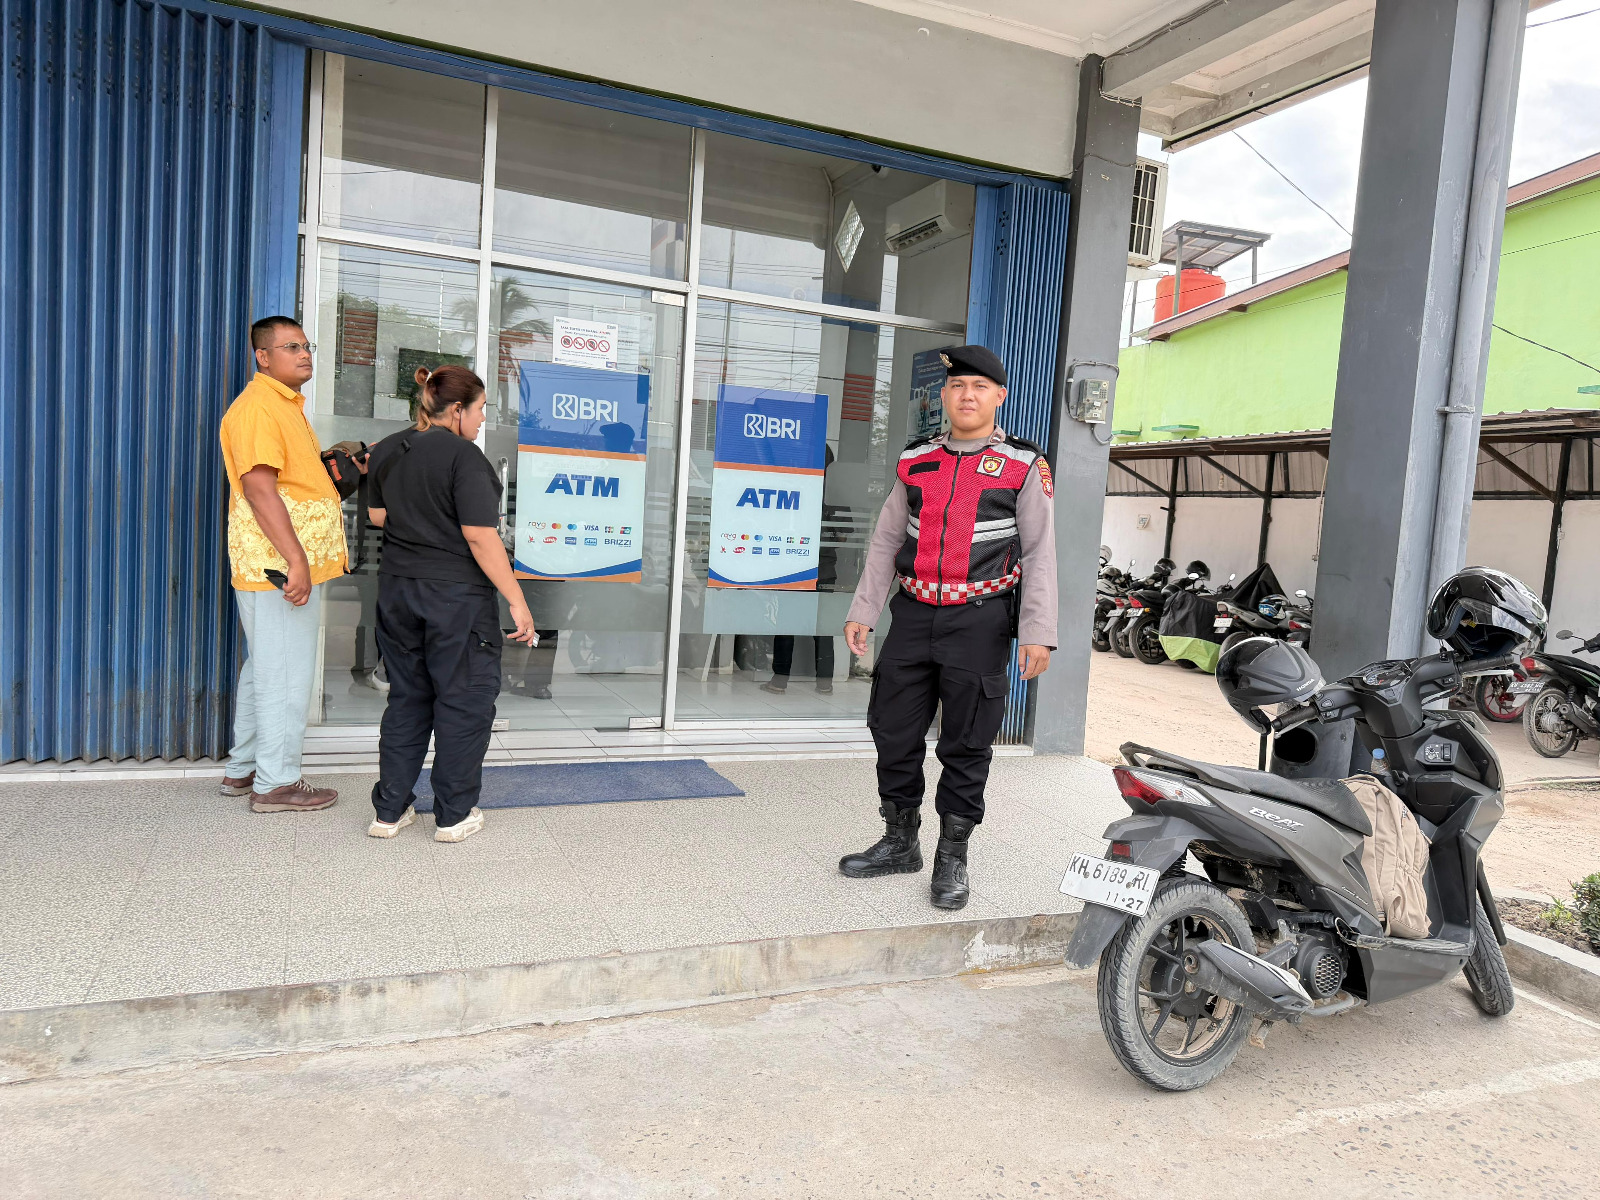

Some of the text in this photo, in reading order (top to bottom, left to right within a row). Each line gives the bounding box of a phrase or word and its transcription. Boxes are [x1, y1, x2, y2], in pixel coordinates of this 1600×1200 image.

[579, 397, 618, 423] BRI
[767, 416, 800, 440] BRI
[545, 472, 619, 498] ATM
[736, 487, 800, 510] ATM
[584, 524, 599, 532] VISA
[604, 538, 632, 546] BRIZZI
[1069, 855, 1090, 876] KH
[1092, 863, 1128, 884] 6189
